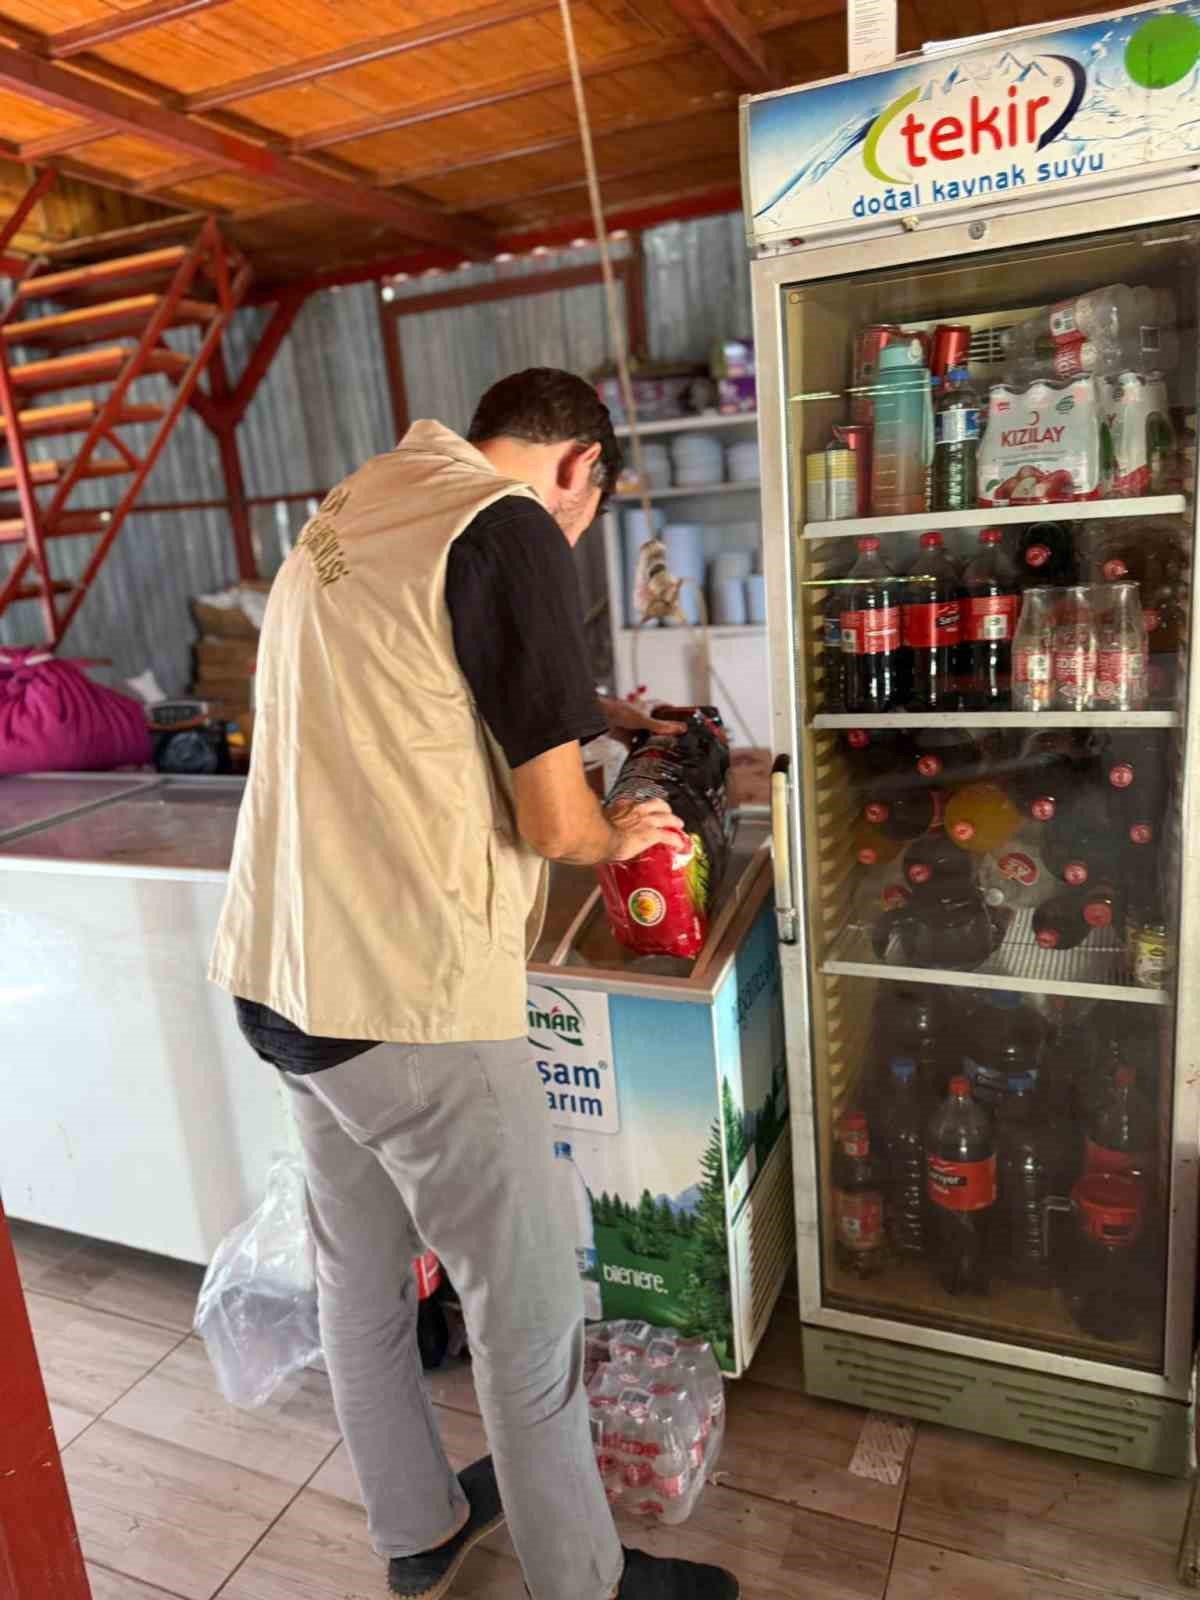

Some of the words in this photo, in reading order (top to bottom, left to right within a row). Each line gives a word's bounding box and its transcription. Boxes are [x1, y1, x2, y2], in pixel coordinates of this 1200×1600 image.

[900, 85, 1050, 168] tekir
[852, 184, 920, 218] doğal
[932, 164, 1026, 201] kaynak
[1037, 153, 1105, 183] suyu
[1001, 425, 1066, 448] KIZILAY
[528, 1008, 582, 1033] INAR
[536, 1060, 600, 1089] şam
[545, 1091, 603, 1117] arım
